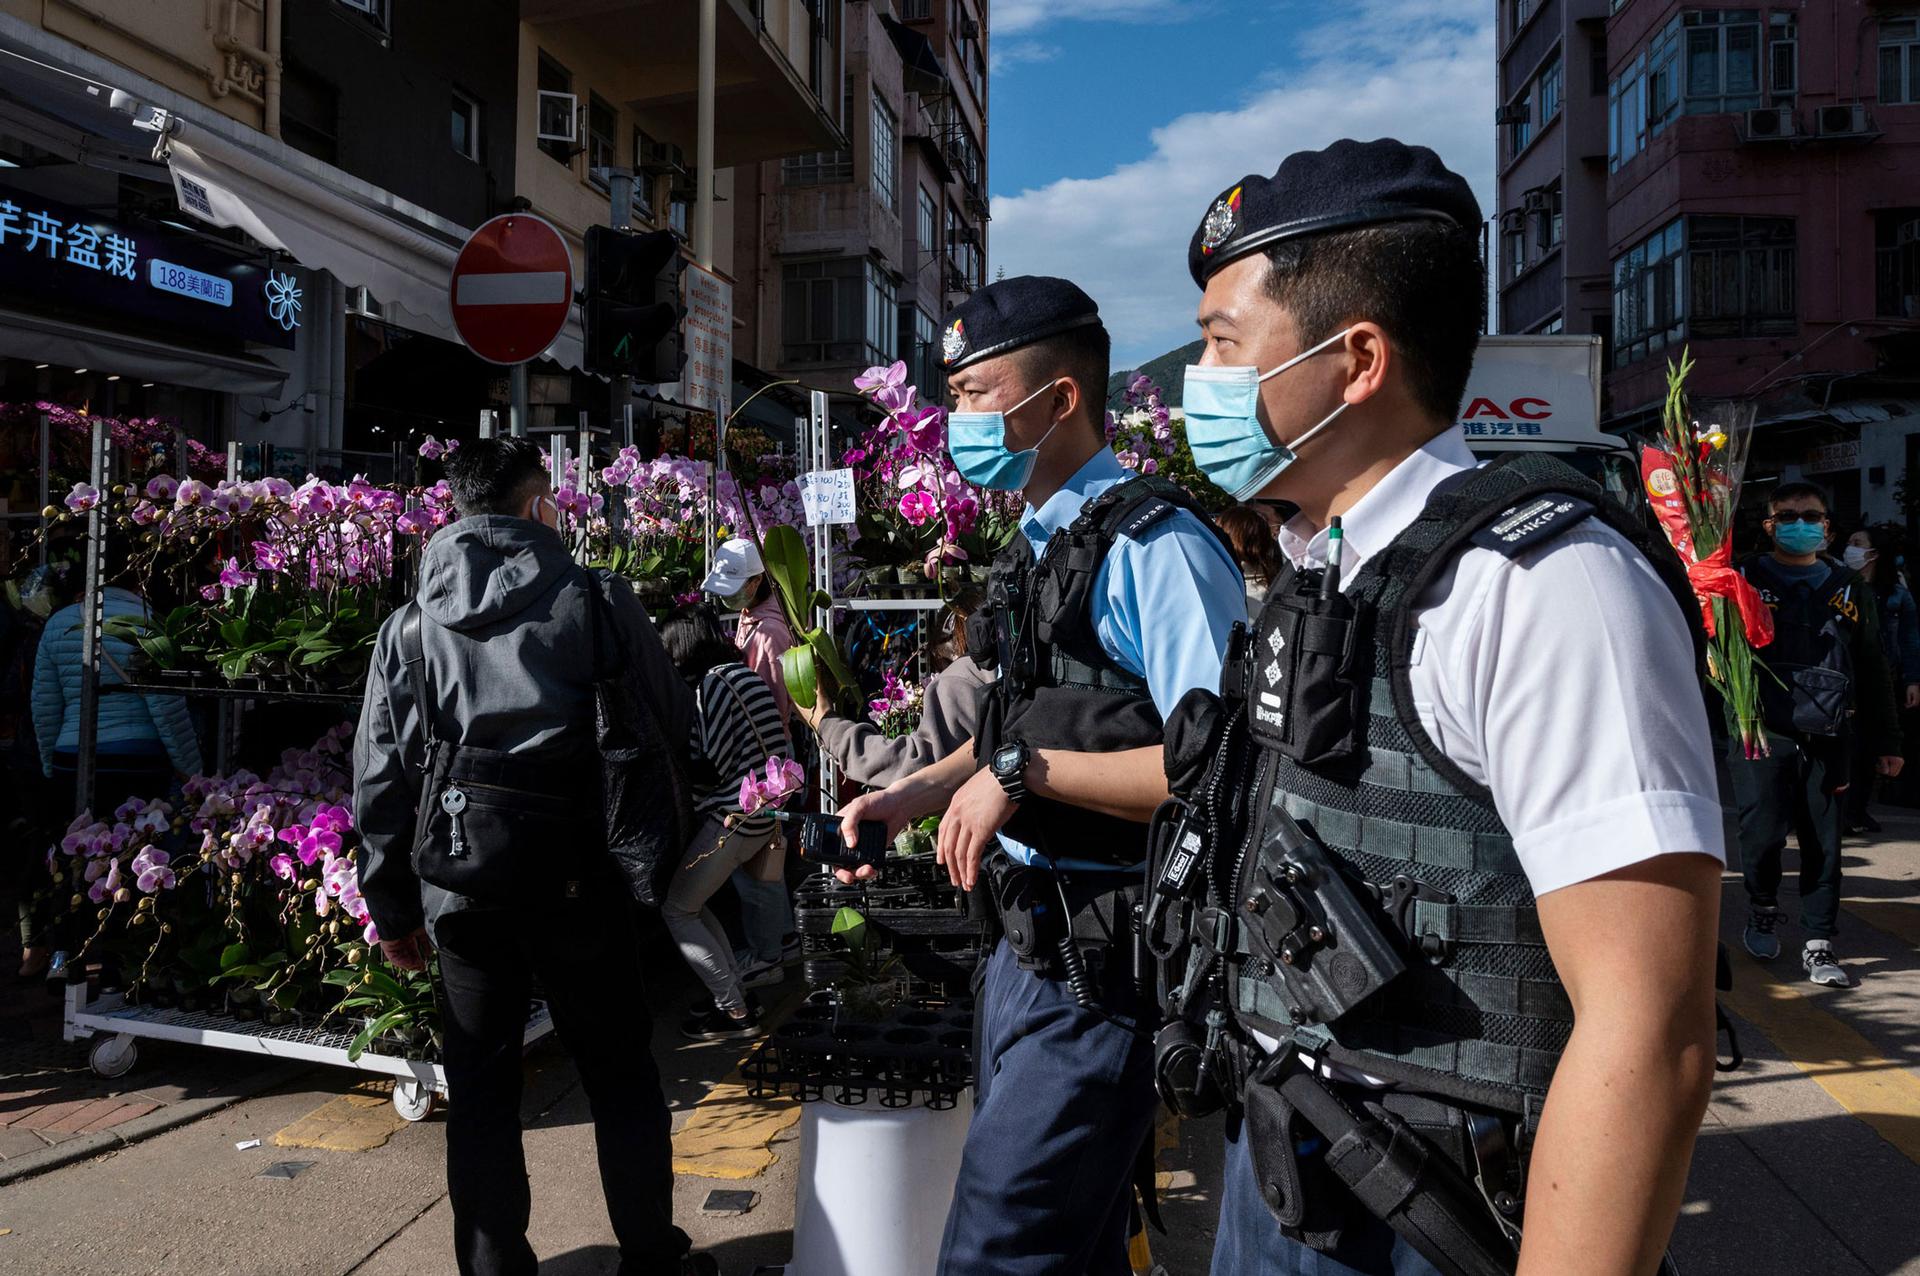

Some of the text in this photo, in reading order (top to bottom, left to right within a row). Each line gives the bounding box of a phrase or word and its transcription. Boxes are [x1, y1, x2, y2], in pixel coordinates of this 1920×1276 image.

[159, 266, 226, 301] 188美蘭店
[700, 275, 720, 293] Vehicle
[691, 289, 710, 305] waiting
[721, 301, 728, 312] be
[695, 305, 724, 324] prosecuted
[687, 316, 730, 343] without warning
